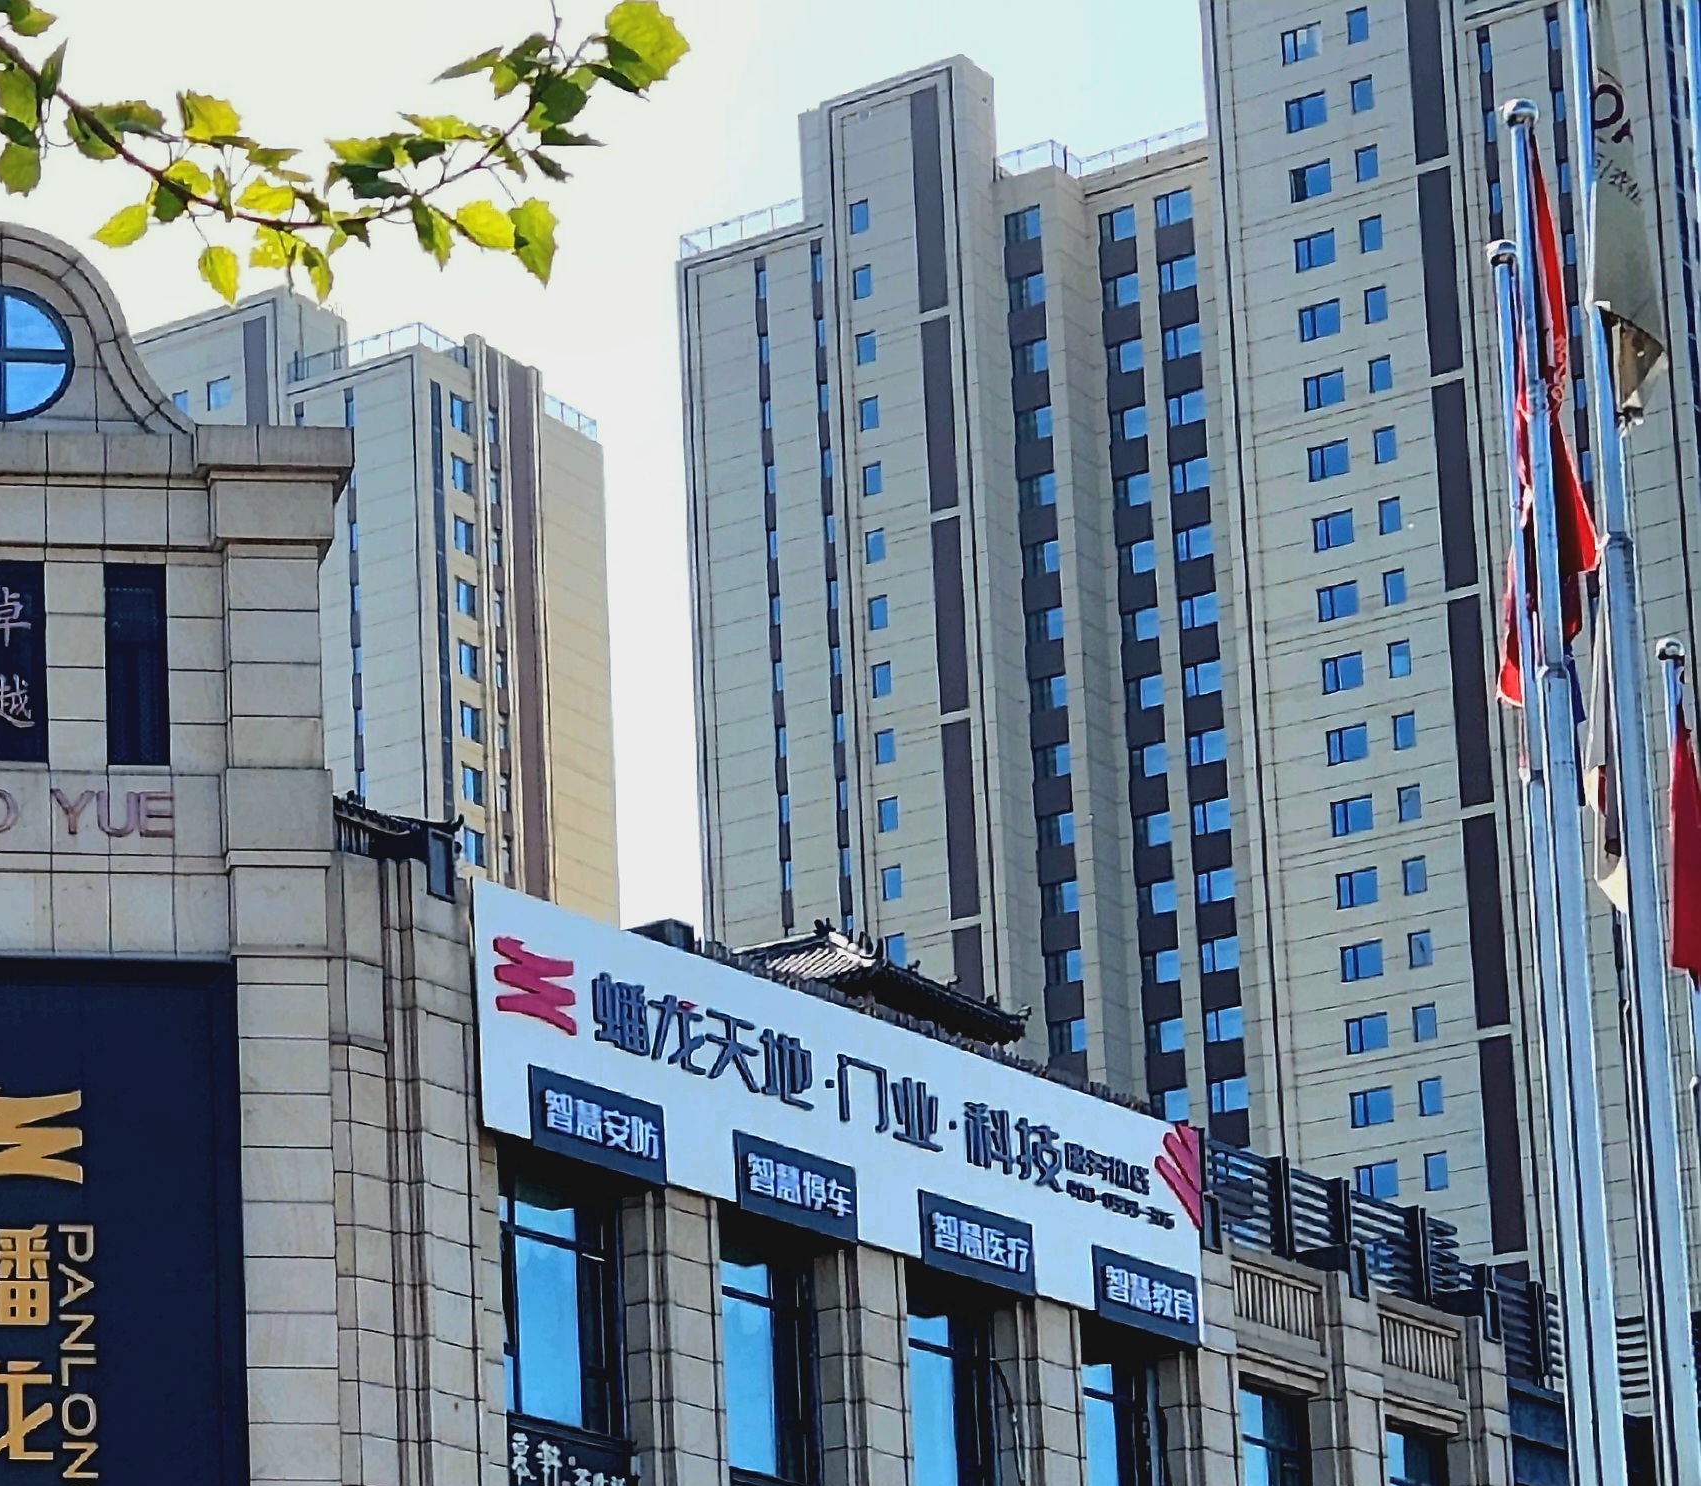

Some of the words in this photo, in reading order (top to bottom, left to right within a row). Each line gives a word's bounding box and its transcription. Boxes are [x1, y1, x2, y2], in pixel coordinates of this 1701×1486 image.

[50, 787, 175, 838] YUE
[544, 1089, 660, 1161] 智慧安防
[748, 1152, 853, 1217] 智慧停车
[931, 1210, 1030, 1274] 智慧医疗
[1104, 1264, 1195, 1326] 智慧教育
